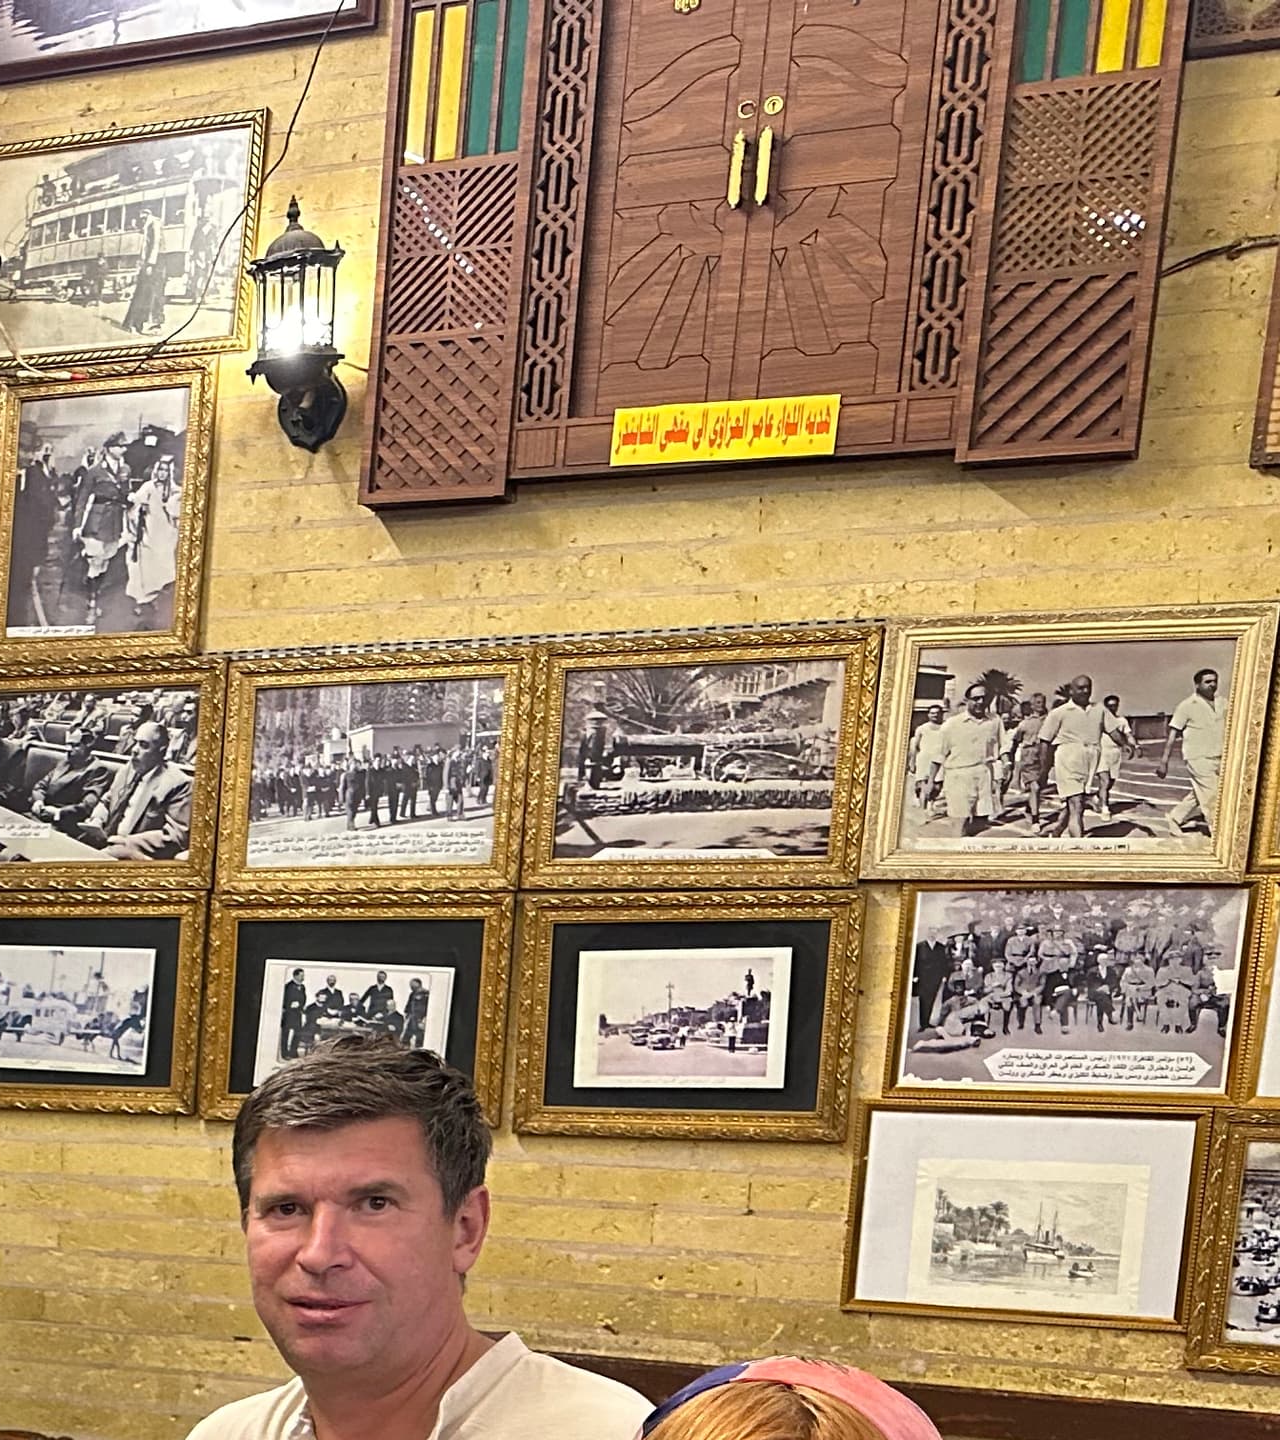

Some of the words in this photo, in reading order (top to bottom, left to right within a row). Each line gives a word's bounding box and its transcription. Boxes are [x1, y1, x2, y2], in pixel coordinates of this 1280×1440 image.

[614, 412, 659, 456] الشابندر
[659, 411, 690, 452] مقهى
[747, 404, 774, 448] عامر
[775, 403, 805, 446] اللواء
